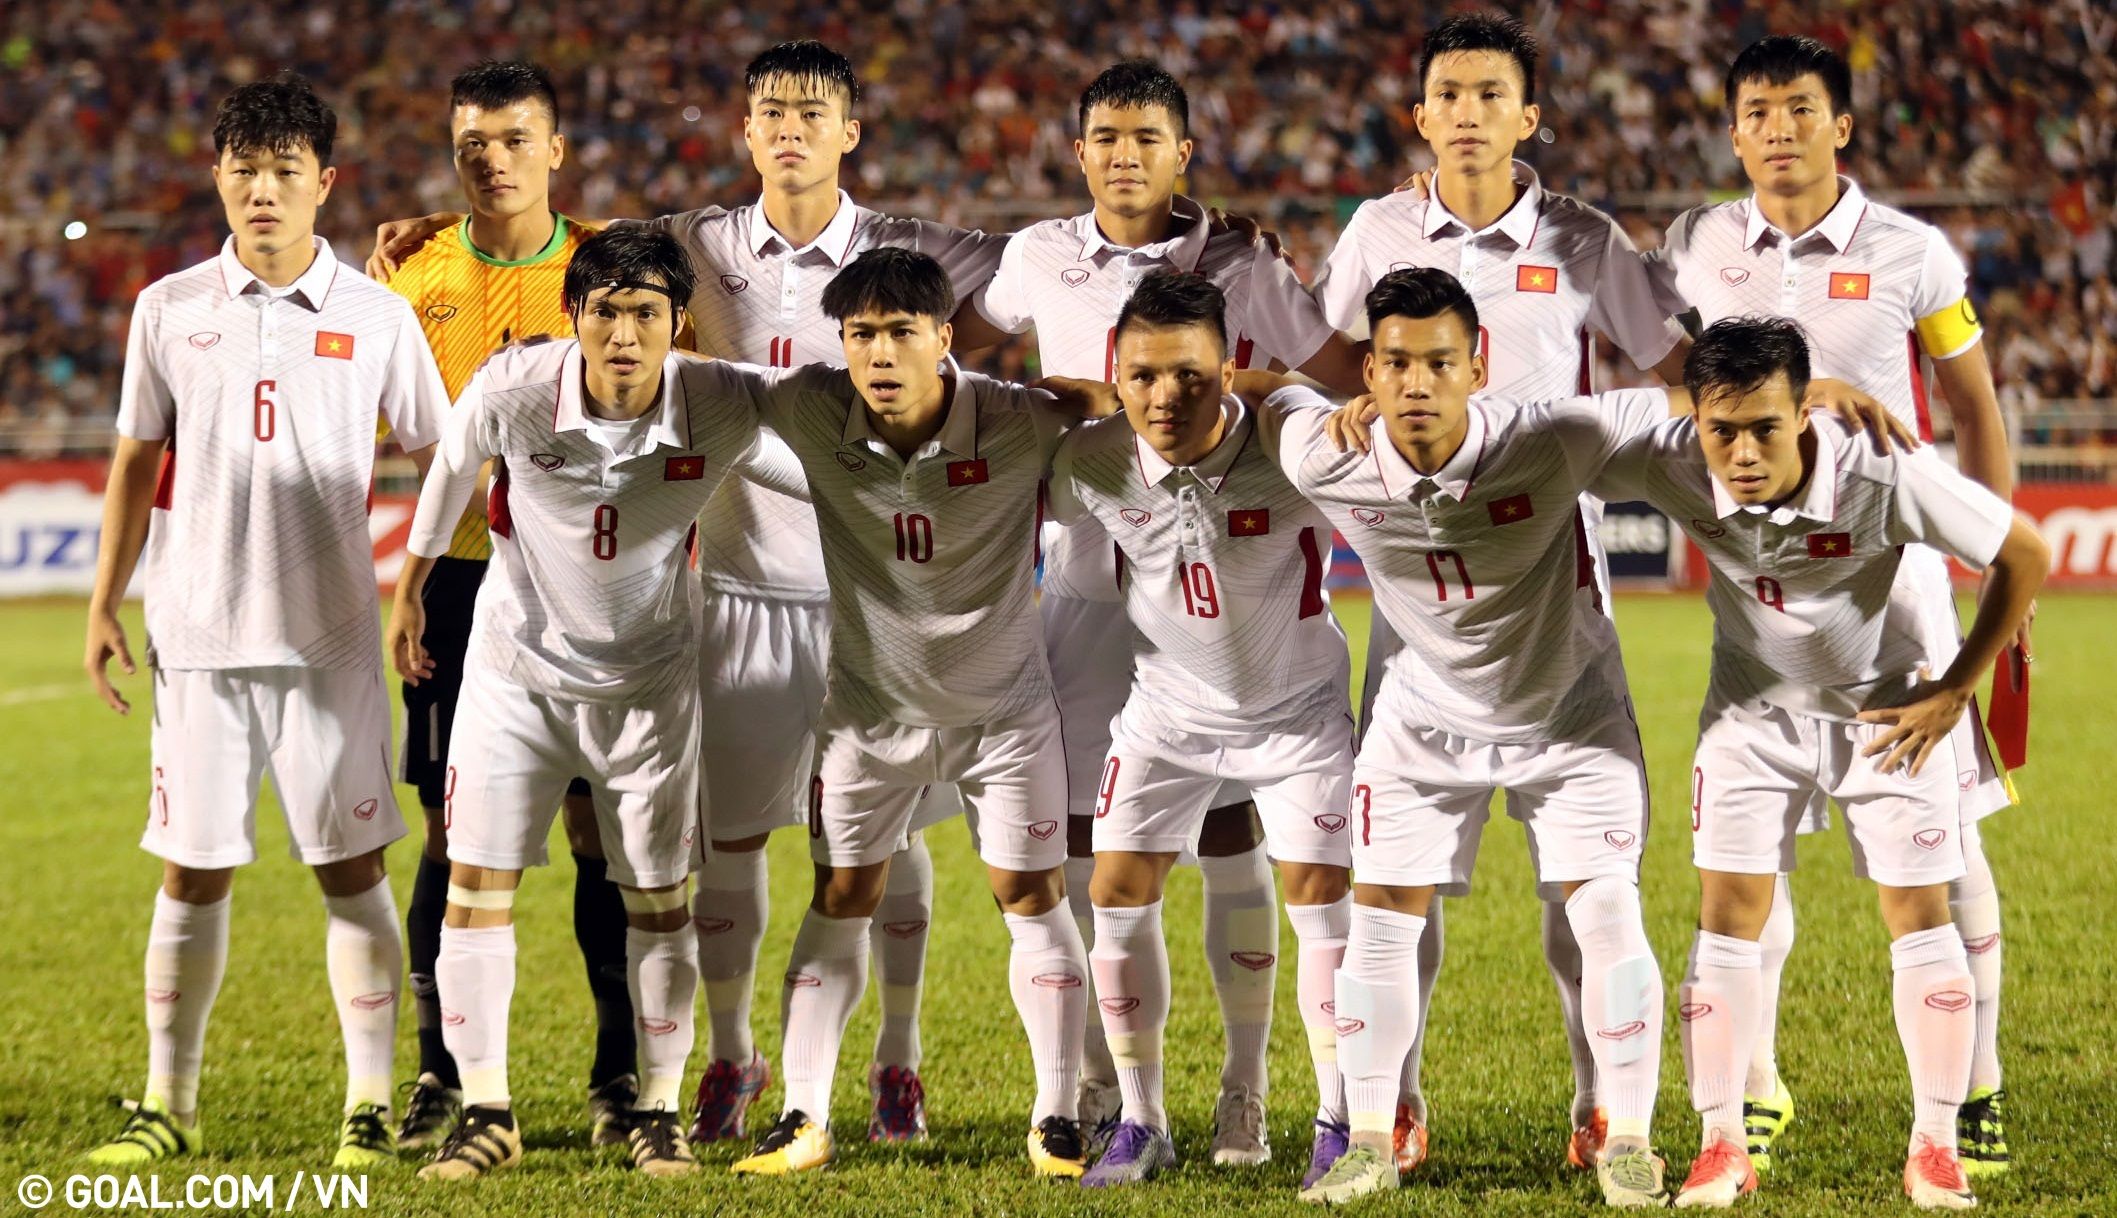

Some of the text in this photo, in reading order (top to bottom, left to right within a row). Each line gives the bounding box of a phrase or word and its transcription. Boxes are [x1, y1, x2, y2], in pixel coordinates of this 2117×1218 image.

[770, 335, 792, 368] 11
[254, 380, 276, 442] 6
[0, 525, 101, 569] UZ
[593, 504, 618, 560] 8
[893, 512, 933, 563] 10
[1178, 561, 1220, 618] 19
[1425, 549, 1474, 601] 17
[1095, 756, 1120, 818] 9
[1692, 766, 1704, 832] 9
